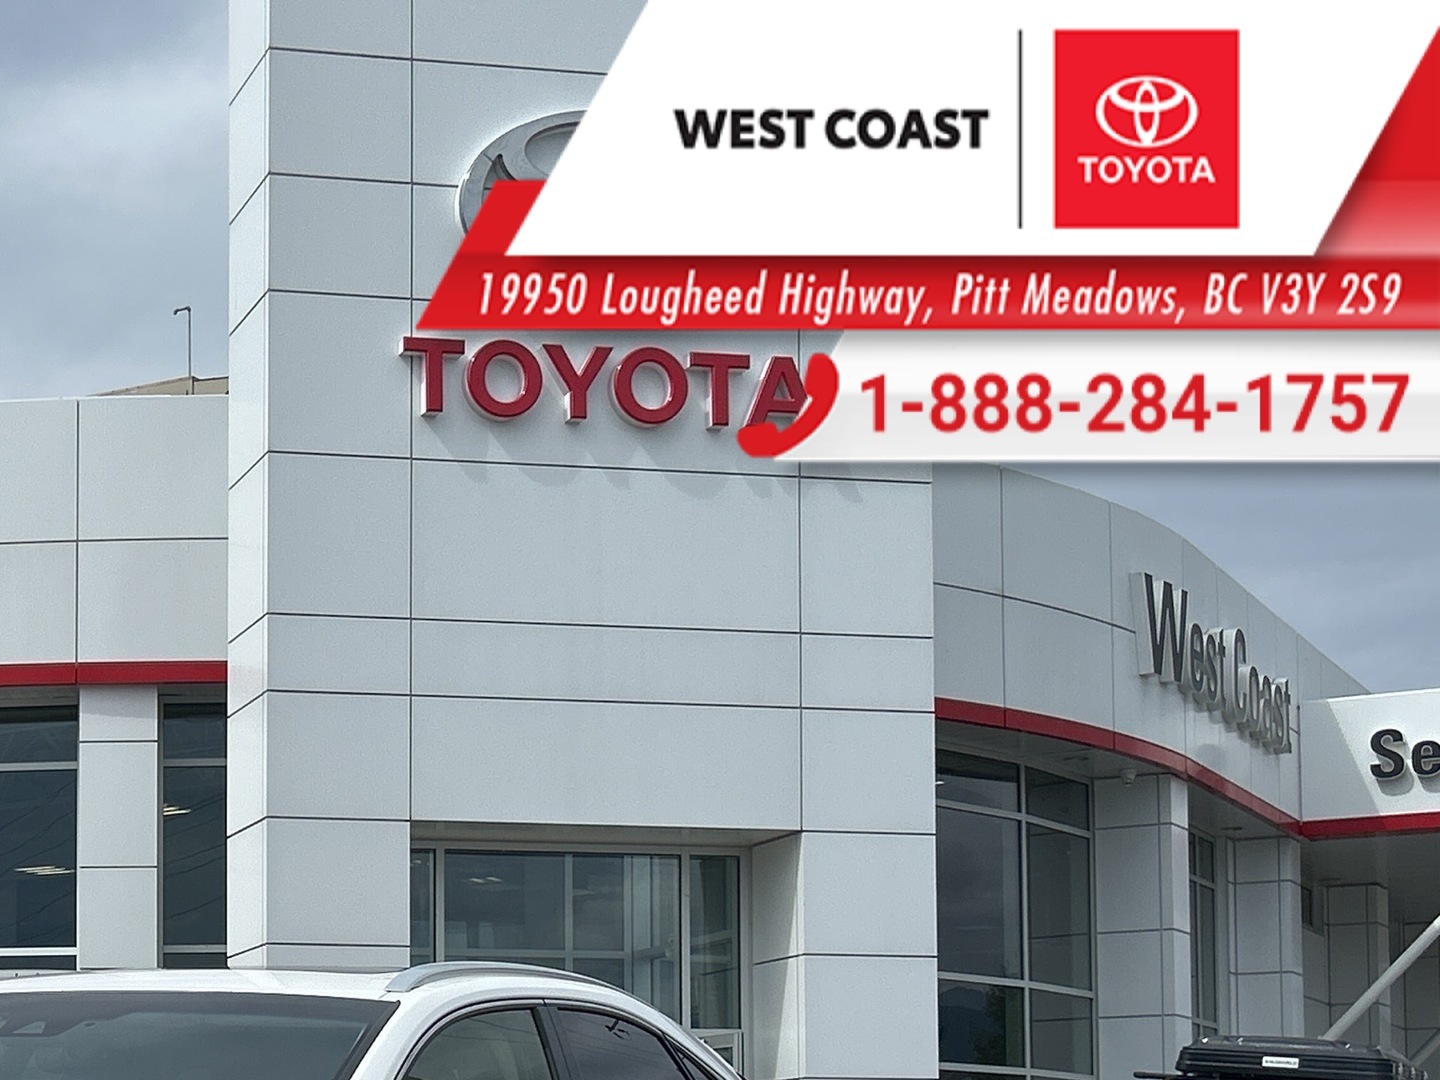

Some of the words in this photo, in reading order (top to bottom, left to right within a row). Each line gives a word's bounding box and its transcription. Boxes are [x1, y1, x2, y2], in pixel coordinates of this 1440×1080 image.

[398, 335, 810, 427] TOYOTA
[1142, 571, 1226, 702] West
[1234, 628, 1293, 754] Coast
